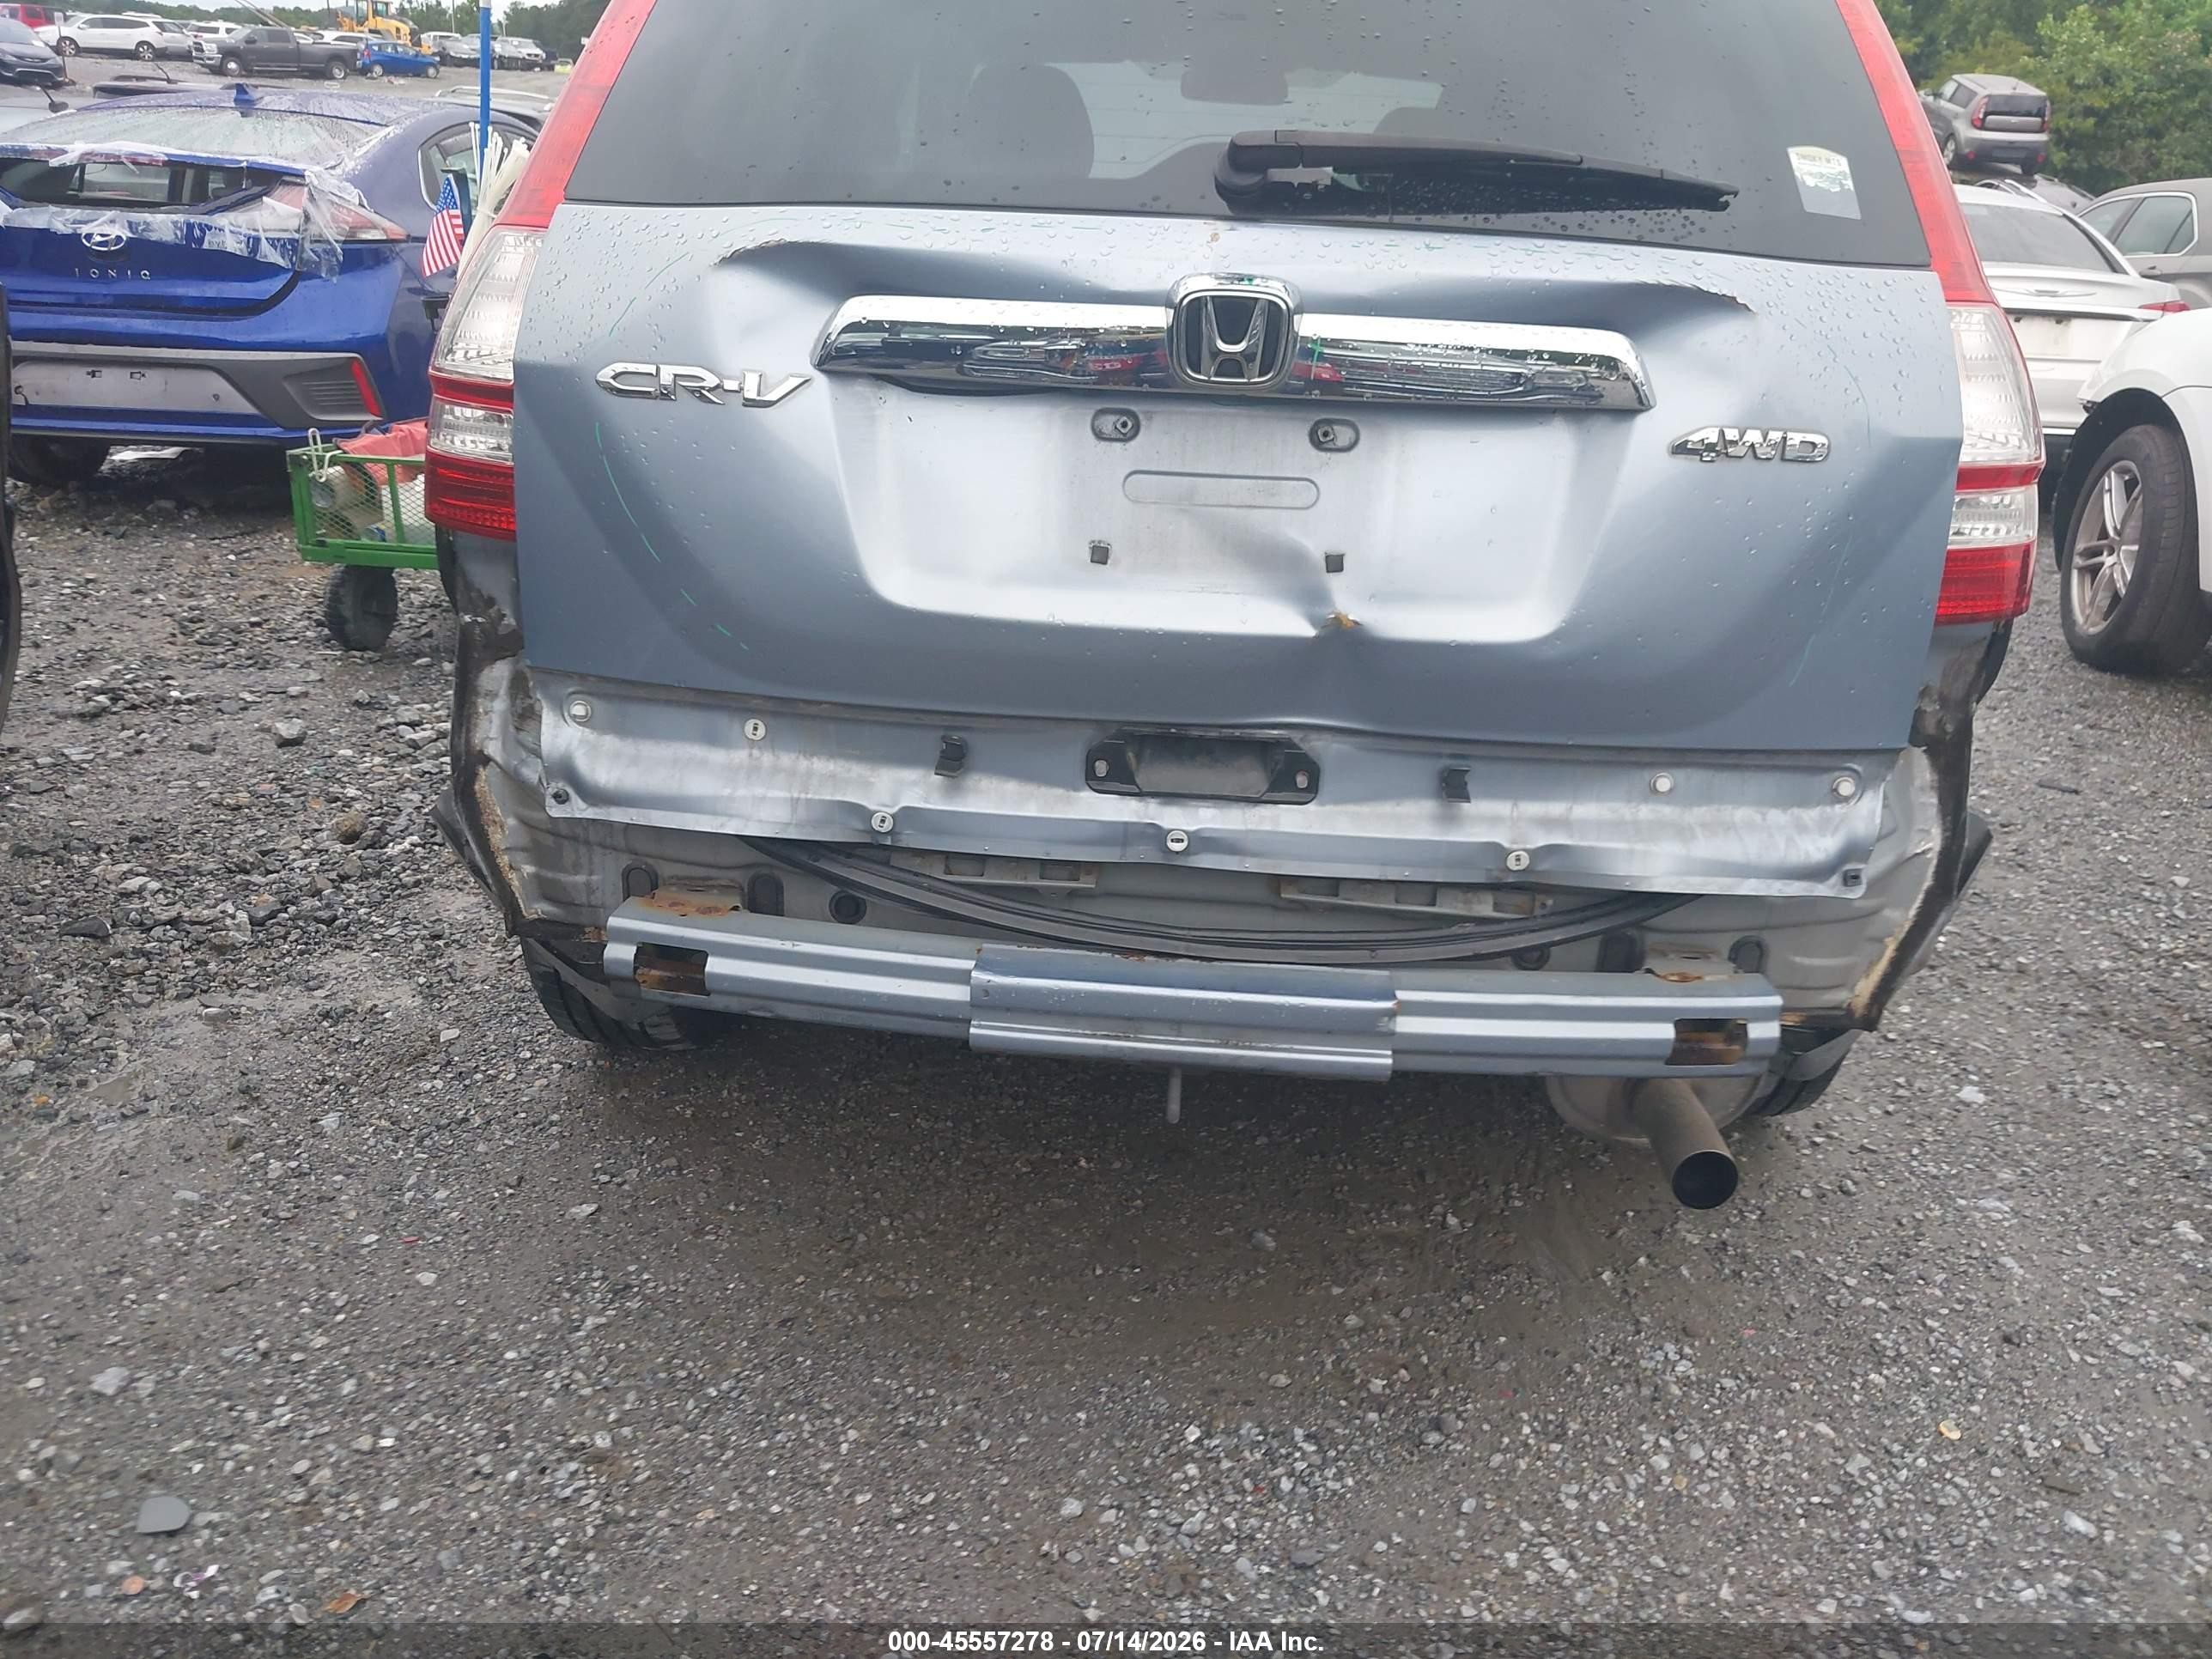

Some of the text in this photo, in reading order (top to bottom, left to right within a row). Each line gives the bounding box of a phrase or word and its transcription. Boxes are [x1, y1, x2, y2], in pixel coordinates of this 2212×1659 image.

[75, 267, 151, 280] IONIQ
[596, 362, 811, 408] CR-V
[1671, 427, 1830, 463] 4WD
